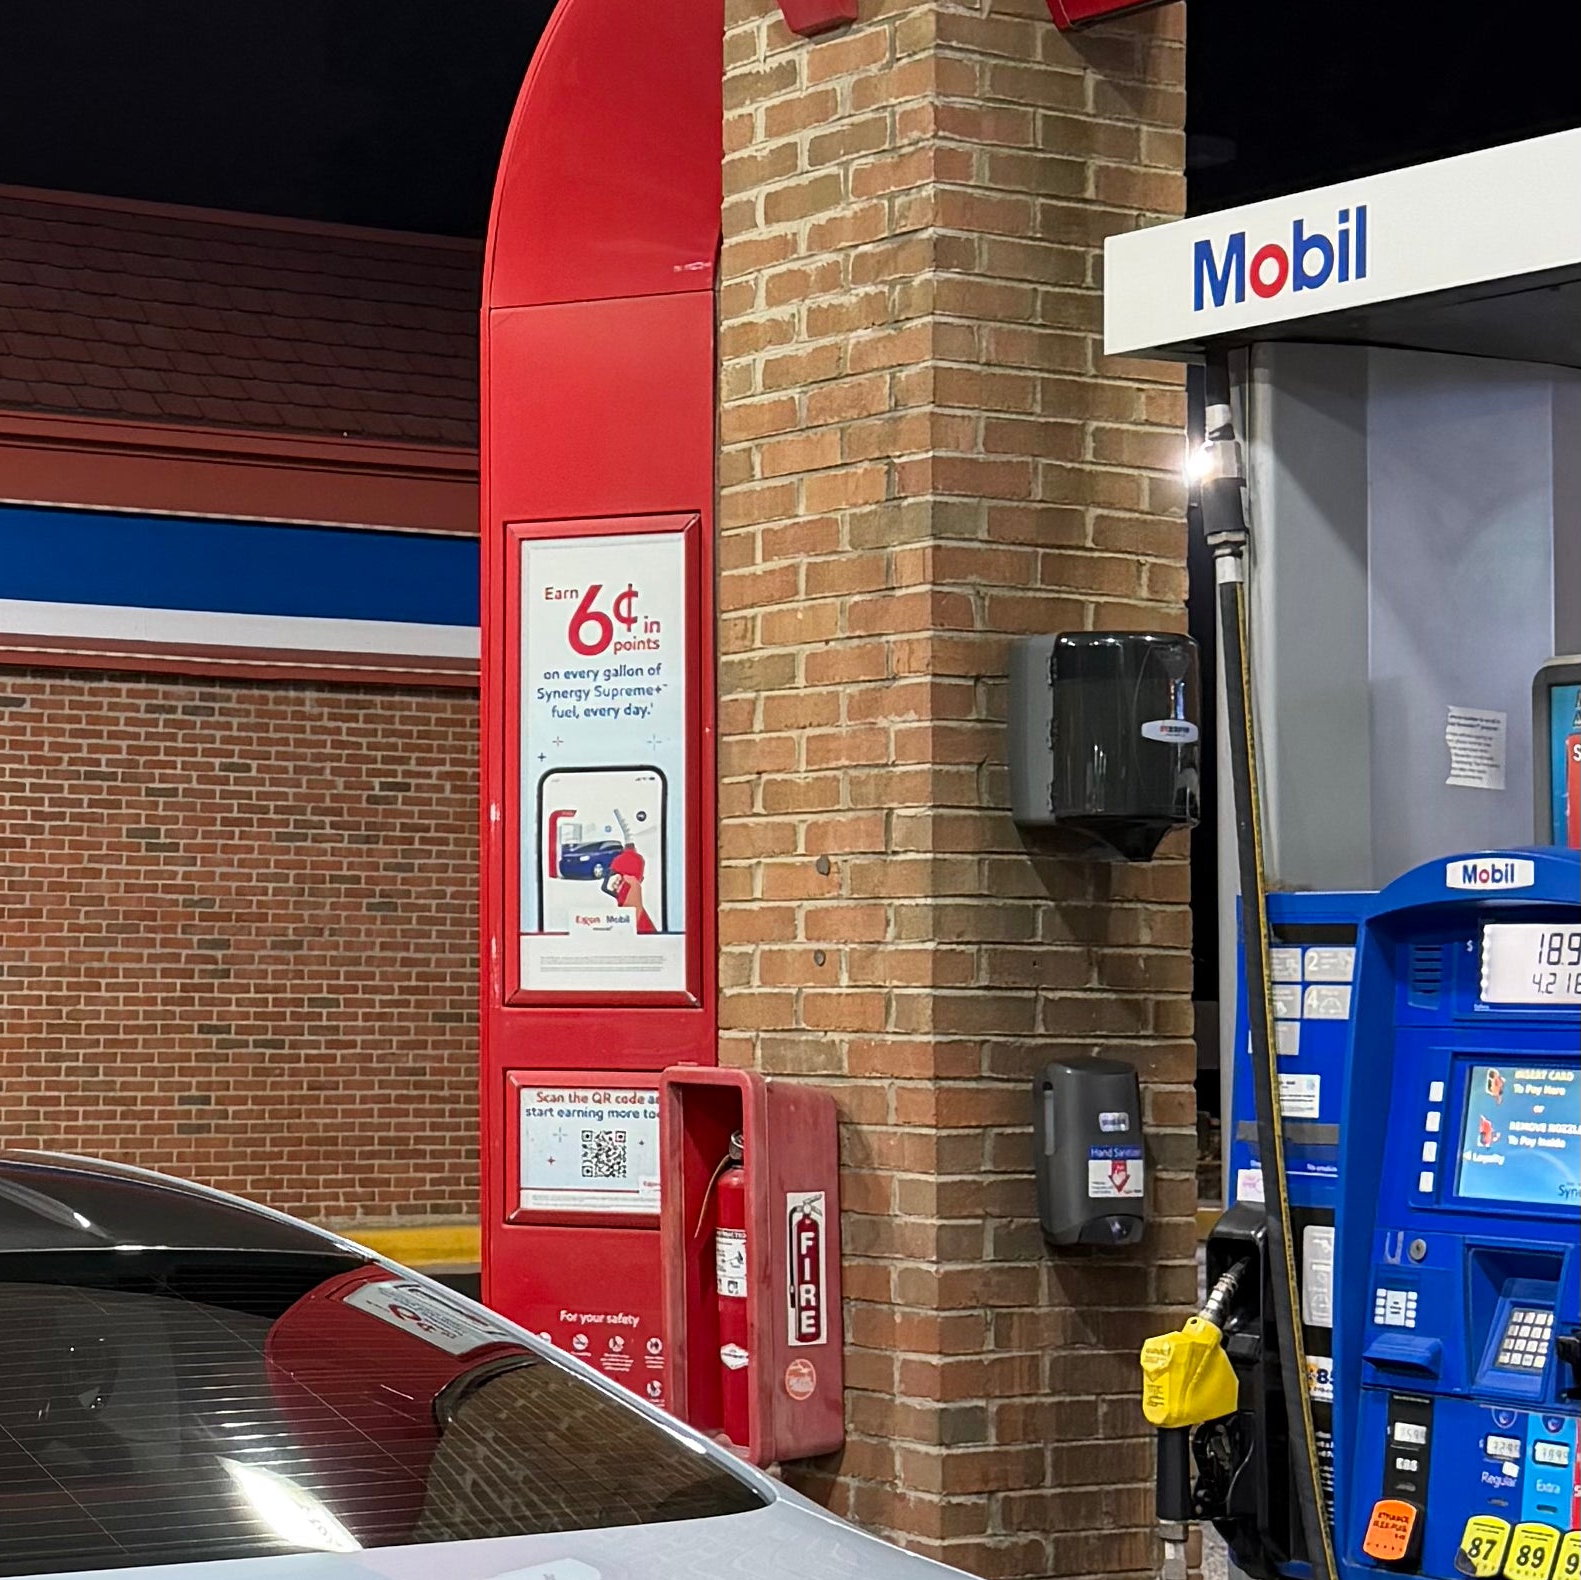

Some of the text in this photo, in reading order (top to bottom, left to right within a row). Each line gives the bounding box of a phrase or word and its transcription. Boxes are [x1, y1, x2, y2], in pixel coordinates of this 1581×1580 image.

[1193, 204, 1369, 312] Mobil
[545, 586, 579, 600] Earn
[644, 615, 661, 634] in
[613, 635, 660, 655] points
[543, 662, 662, 682] on every gallon of
[537, 687, 590, 702] Synergy
[551, 705, 580, 719] fuel,
[583, 706, 620, 720] every
[1462, 862, 1515, 885] Mobil
[537, 1091, 564, 1104] Scan
[569, 1092, 588, 1104] the
[592, 1092, 611, 1104] QR
[615, 1092, 645, 1105] code
[525, 1107, 554, 1117] start
[557, 1107, 604, 1121] earning
[608, 1110, 640, 1119] more
[799, 1231, 817, 1335] FIRE
[560, 1309, 640, 1328] For your safety
[1468, 1536, 1498, 1561] 87
[1516, 1544, 1546, 1569] 89
